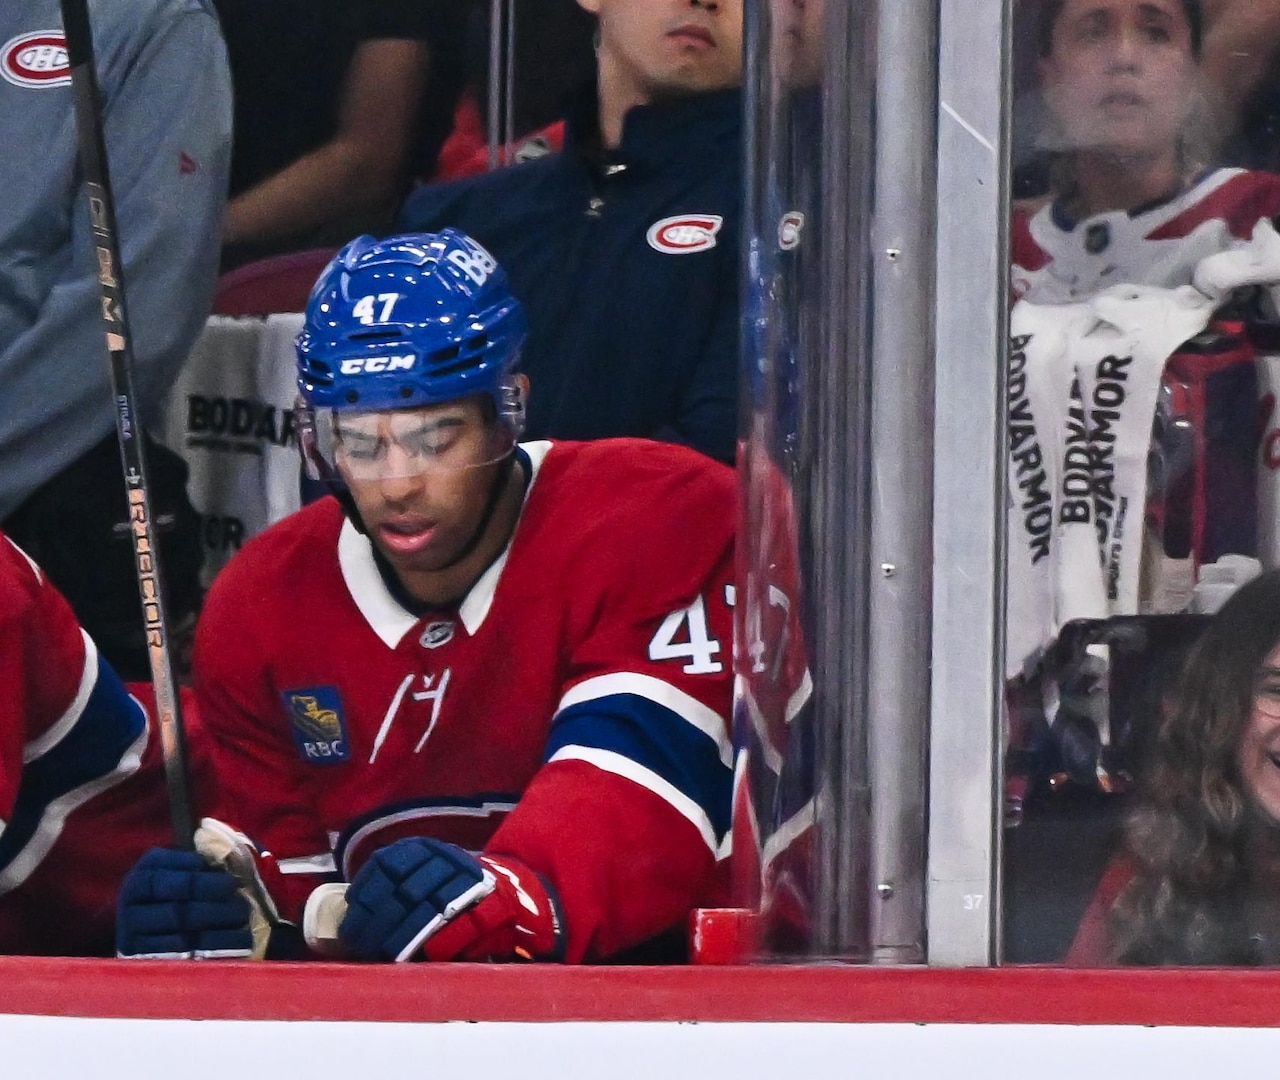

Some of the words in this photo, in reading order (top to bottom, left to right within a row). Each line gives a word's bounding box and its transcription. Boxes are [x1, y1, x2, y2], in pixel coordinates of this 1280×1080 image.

[352, 292, 400, 325] 47
[340, 354, 416, 374] CCM
[303, 739, 346, 759] RBC
[963, 894, 984, 910] 37
